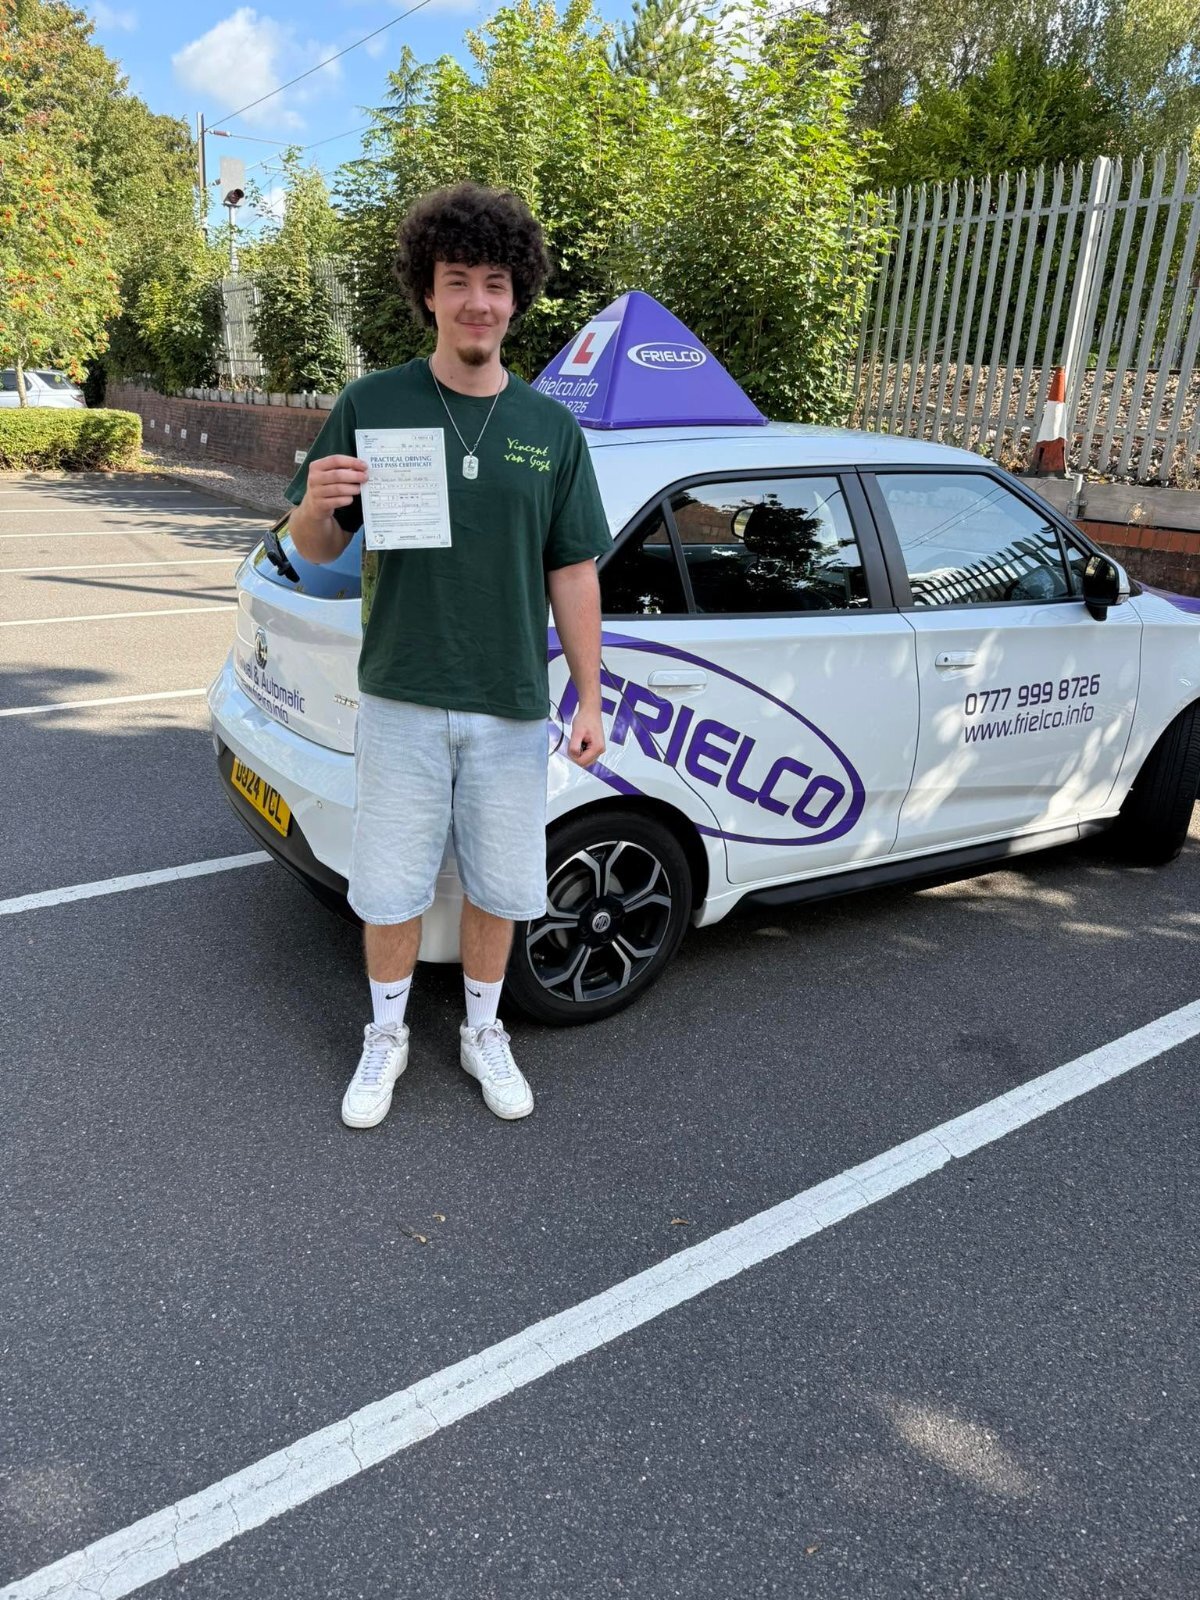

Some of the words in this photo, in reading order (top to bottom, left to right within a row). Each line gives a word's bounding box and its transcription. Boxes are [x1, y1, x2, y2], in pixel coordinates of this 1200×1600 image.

[572, 332, 596, 364] L
[640, 350, 701, 363] FRIELCO
[536, 376, 599, 398] frielco.info
[507, 437, 549, 457] Vincent
[529, 454, 551, 472] Gogh
[261, 671, 306, 714] Automatic
[964, 687, 1012, 716] 0777
[1017, 681, 1053, 707] 999
[1058, 673, 1100, 701] 8726
[964, 702, 1095, 744] www.frielco.info
[558, 668, 846, 829] FRIELCO
[262, 782, 282, 825] VCL
